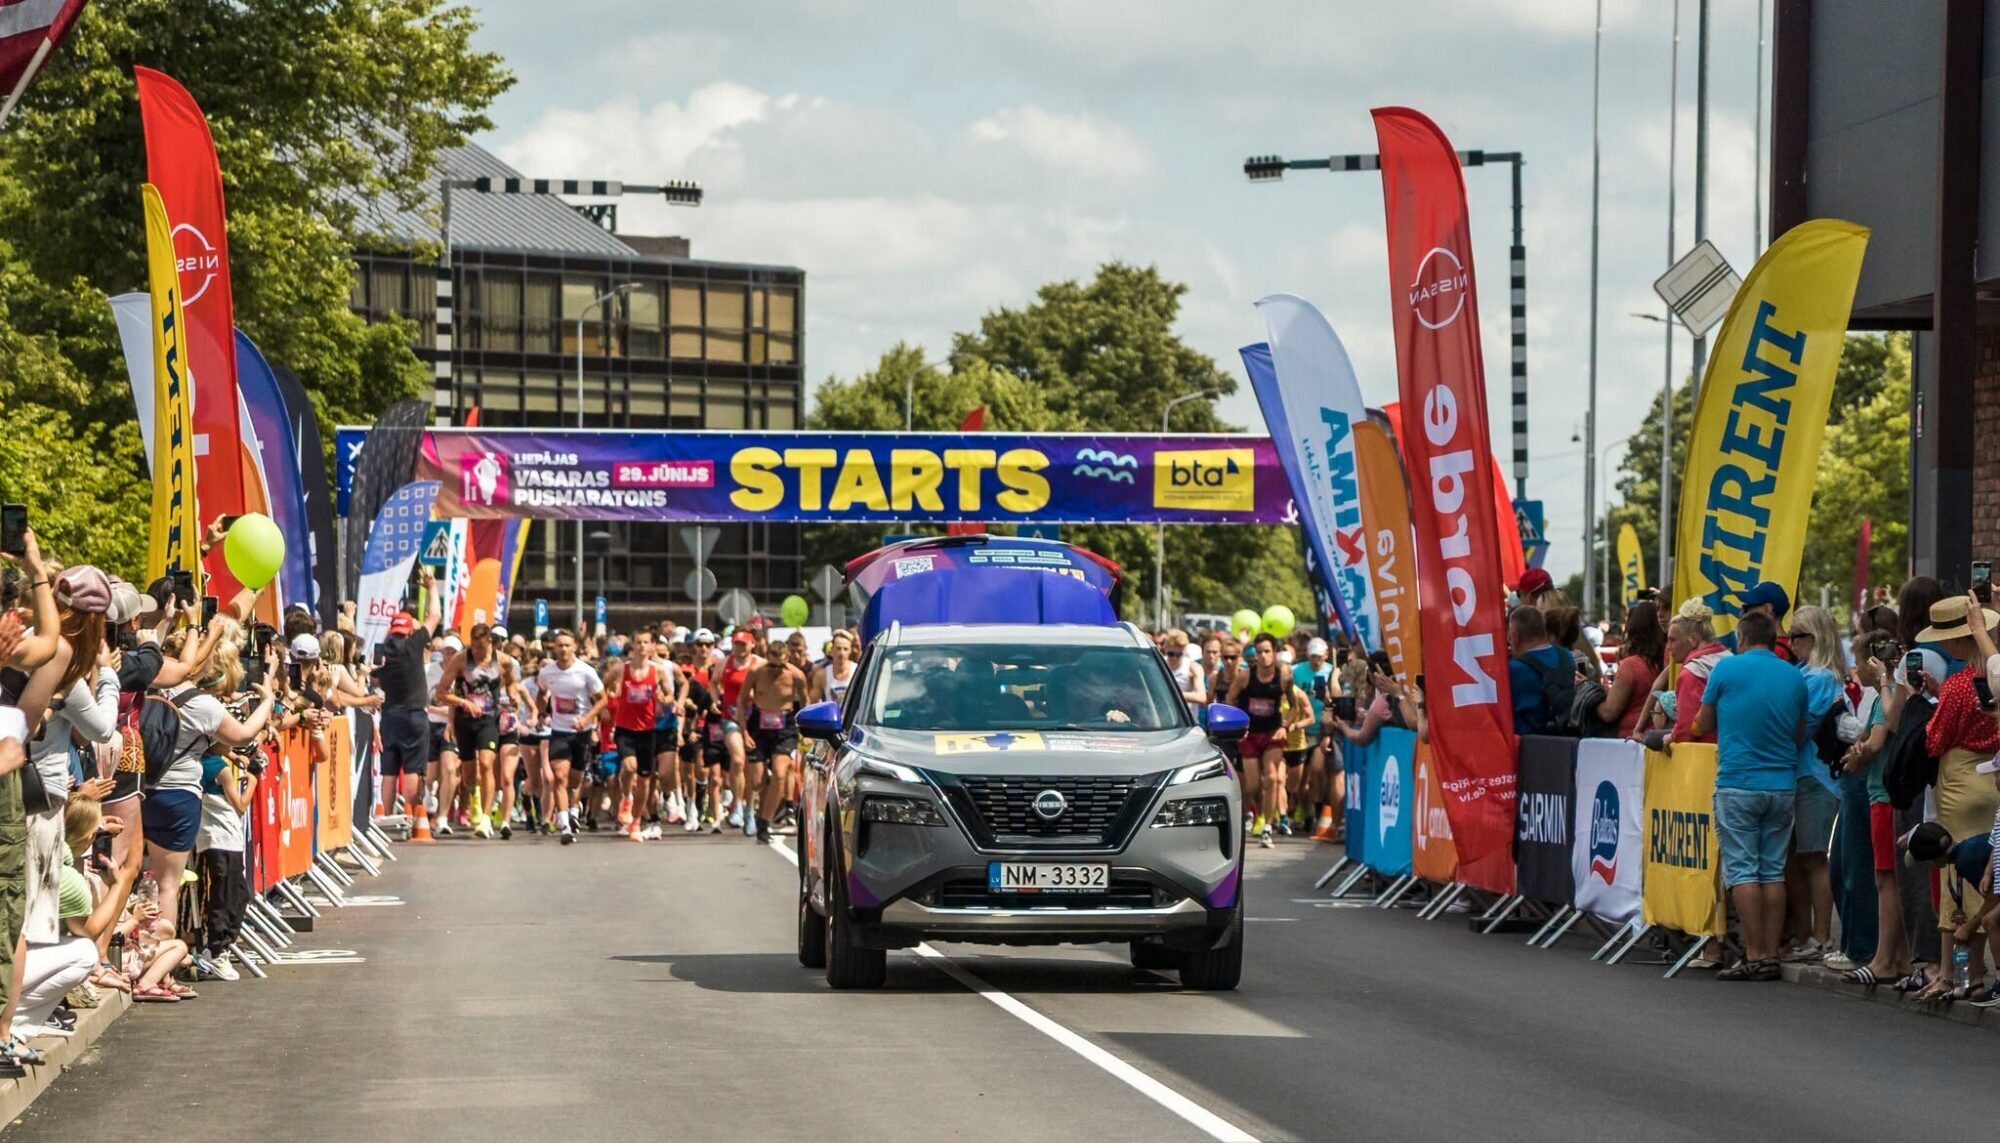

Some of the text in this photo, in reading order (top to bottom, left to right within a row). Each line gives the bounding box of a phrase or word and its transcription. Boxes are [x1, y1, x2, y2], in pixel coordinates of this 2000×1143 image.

[514, 452, 579, 466] LIEPĀJAS
[1699, 300, 1807, 636] MIRENT
[514, 470, 610, 488] VASARAS
[619, 464, 709, 482] 29. JŪNIJS
[730, 446, 1051, 512] STARTS
[1171, 459, 1223, 487] bta
[514, 489, 668, 507] PUSMARATONS
[369, 597, 397, 616] bta
[1031, 800, 1068, 809] NISSAN
[1650, 808, 1710, 870] RAMIRENT
[1006, 866, 1105, 886] NM-3332
